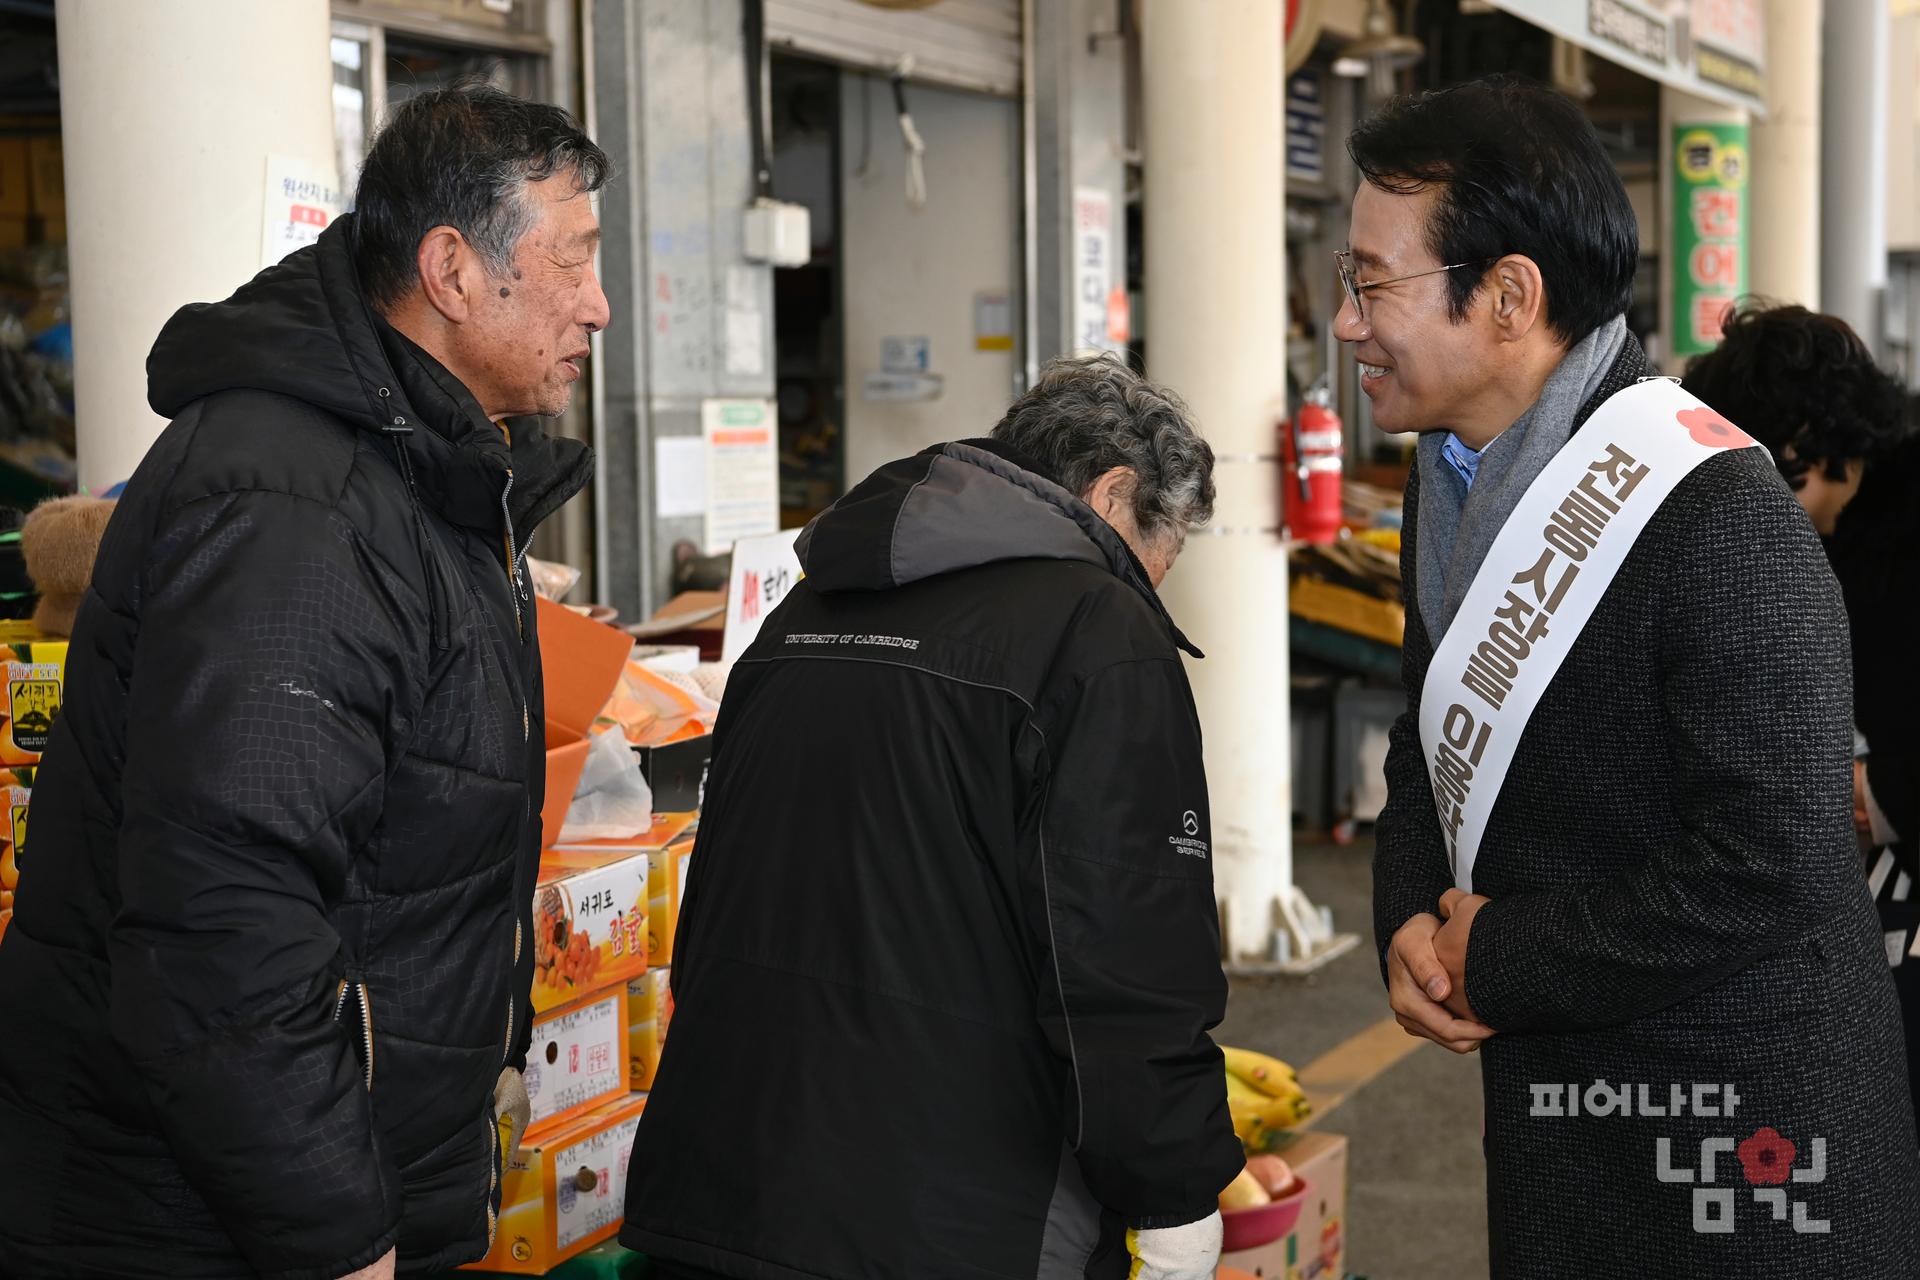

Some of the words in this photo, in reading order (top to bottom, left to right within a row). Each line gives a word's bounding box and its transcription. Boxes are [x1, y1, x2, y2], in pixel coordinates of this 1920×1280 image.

[1461, 443, 1651, 711] 전통시장을
[785, 634, 838, 644] UNIVERSITY
[839, 634, 854, 644] OF
[854, 634, 920, 650] CAMBRIDGE
[39, 668, 60, 679] SET
[579, 889, 615, 918] 서귀포
[608, 904, 645, 957] 감귤
